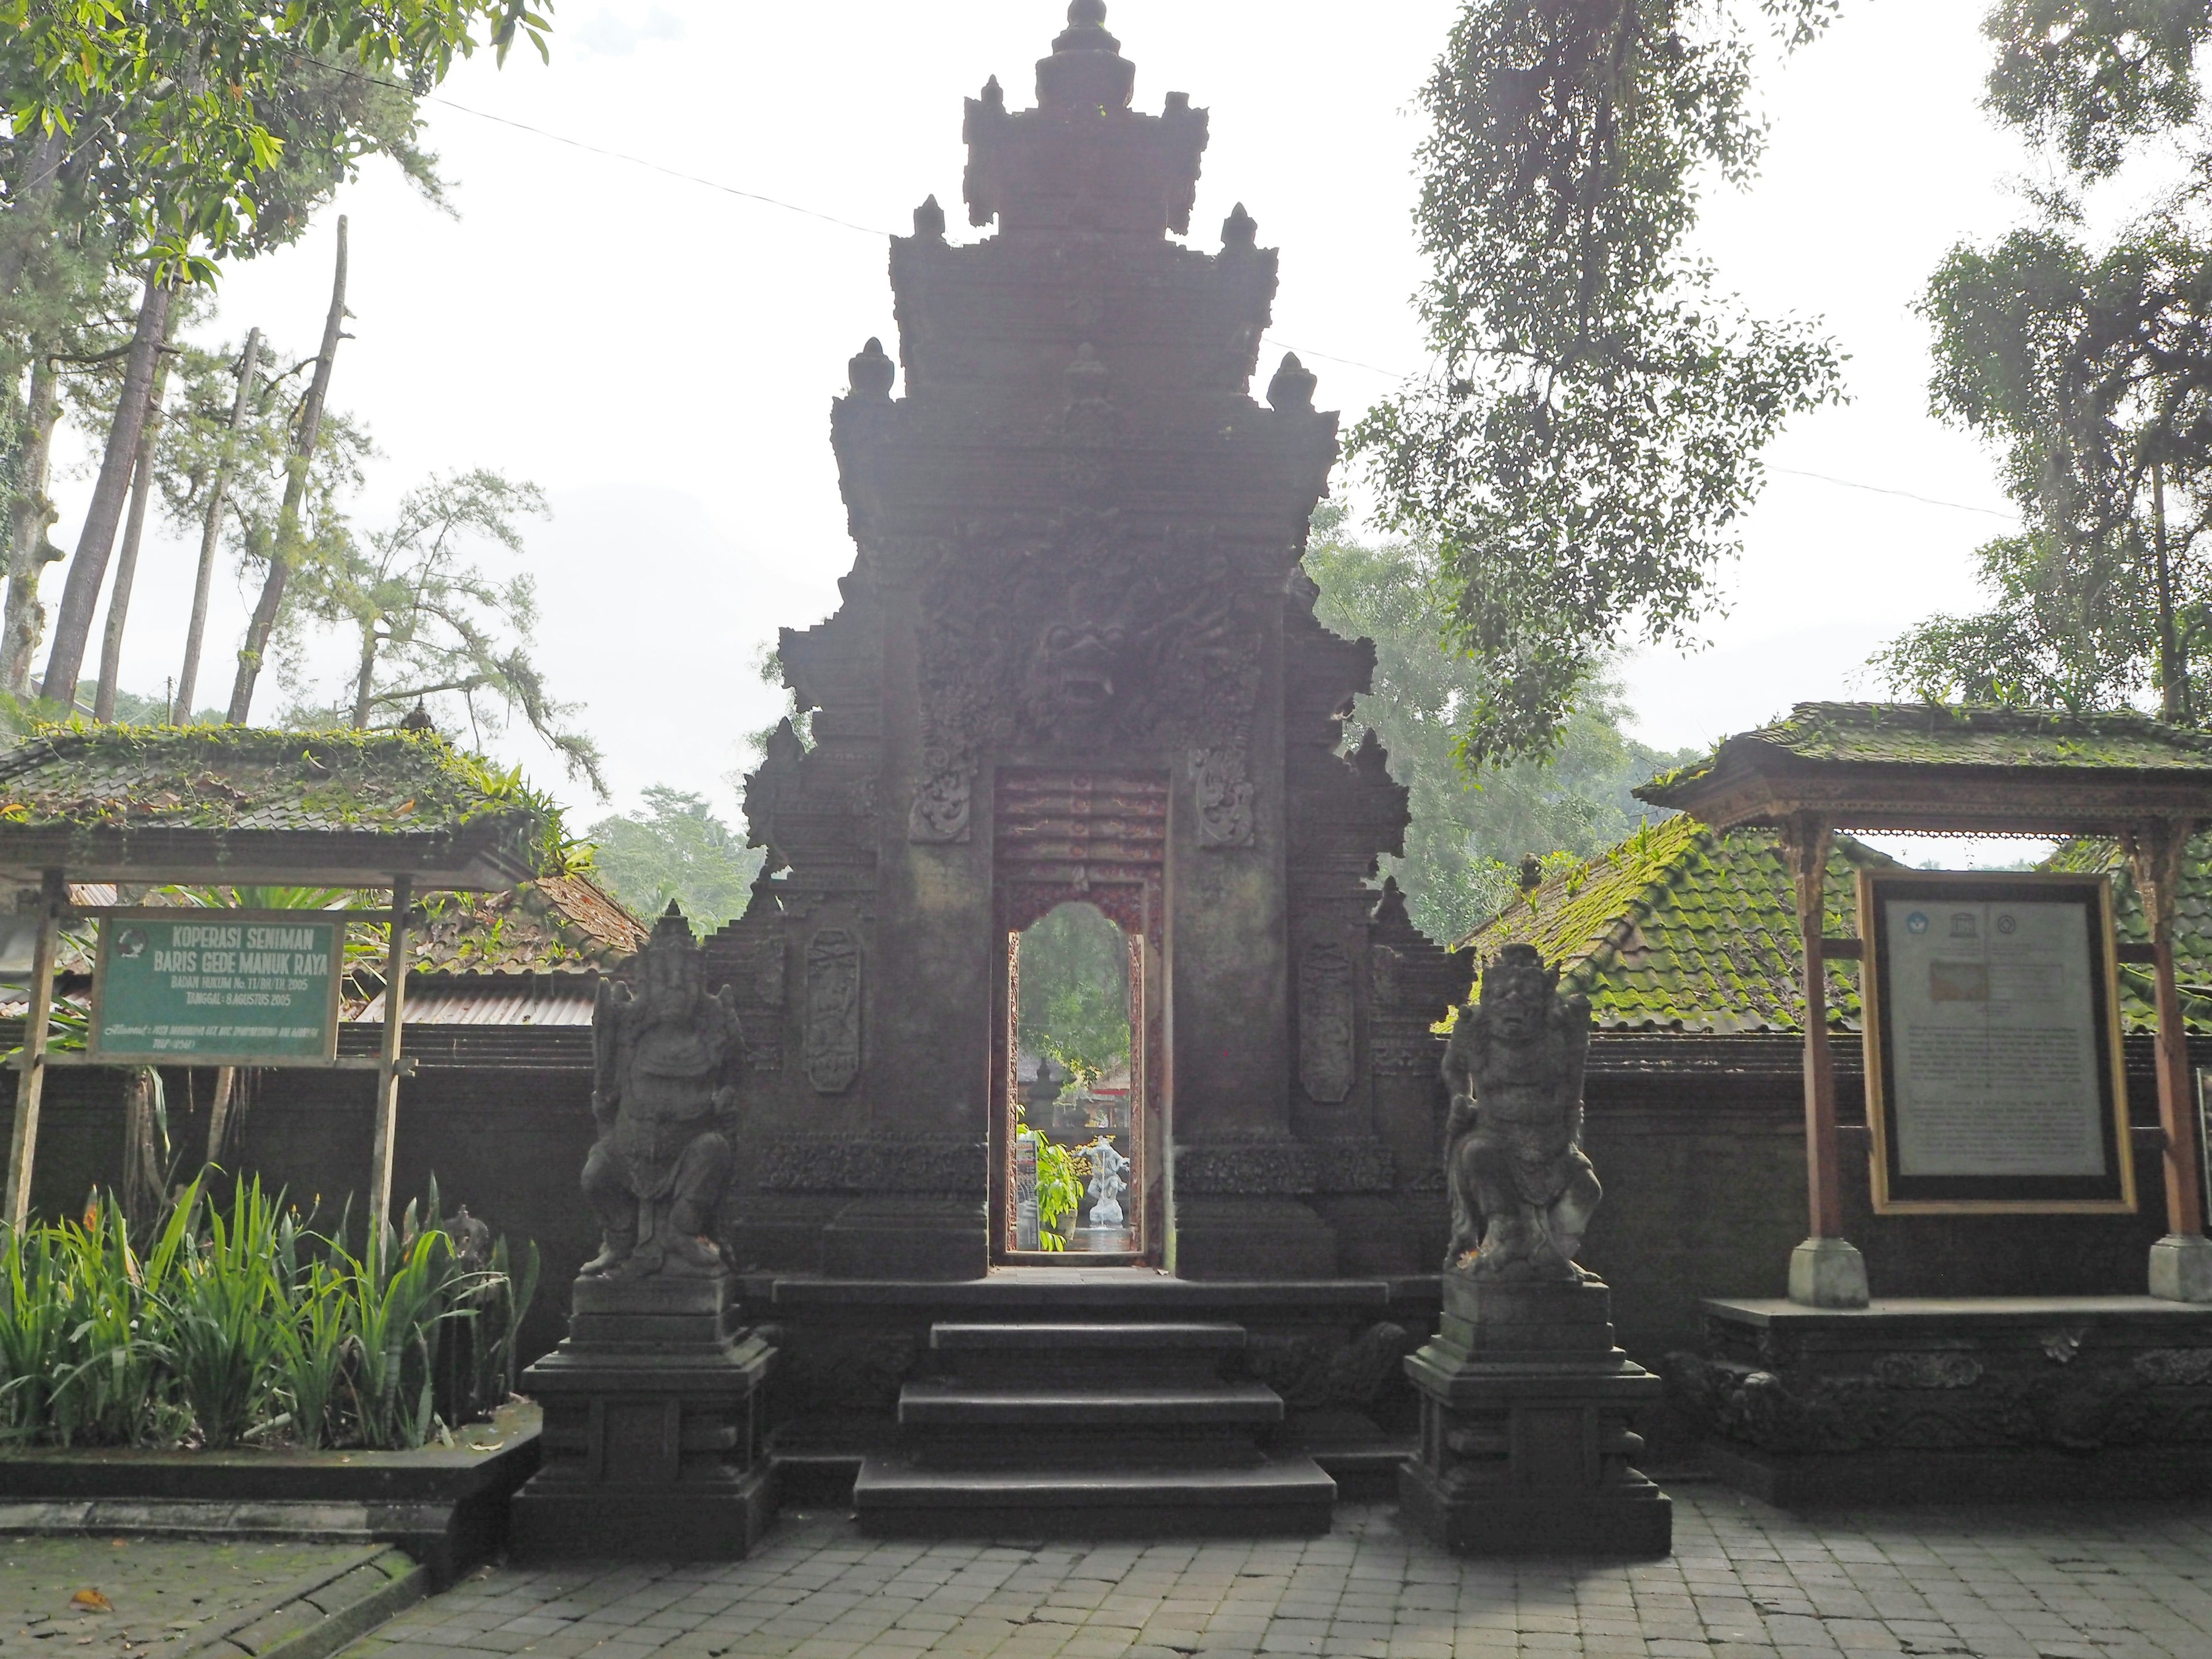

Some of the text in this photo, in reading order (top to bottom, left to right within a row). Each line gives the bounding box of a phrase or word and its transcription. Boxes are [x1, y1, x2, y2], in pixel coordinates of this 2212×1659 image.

[172, 926, 315, 950] KOPERASI SENIMAN
[154, 950, 328, 975] BARIS GEDE MANUK RAYA
[171, 975, 199, 988] BADAN
[202, 976, 231, 989] HUKUM
[287, 979, 308, 991] 2005
[232, 993, 270, 1005] AGUSTUS
[270, 994, 291, 1006] 2005
